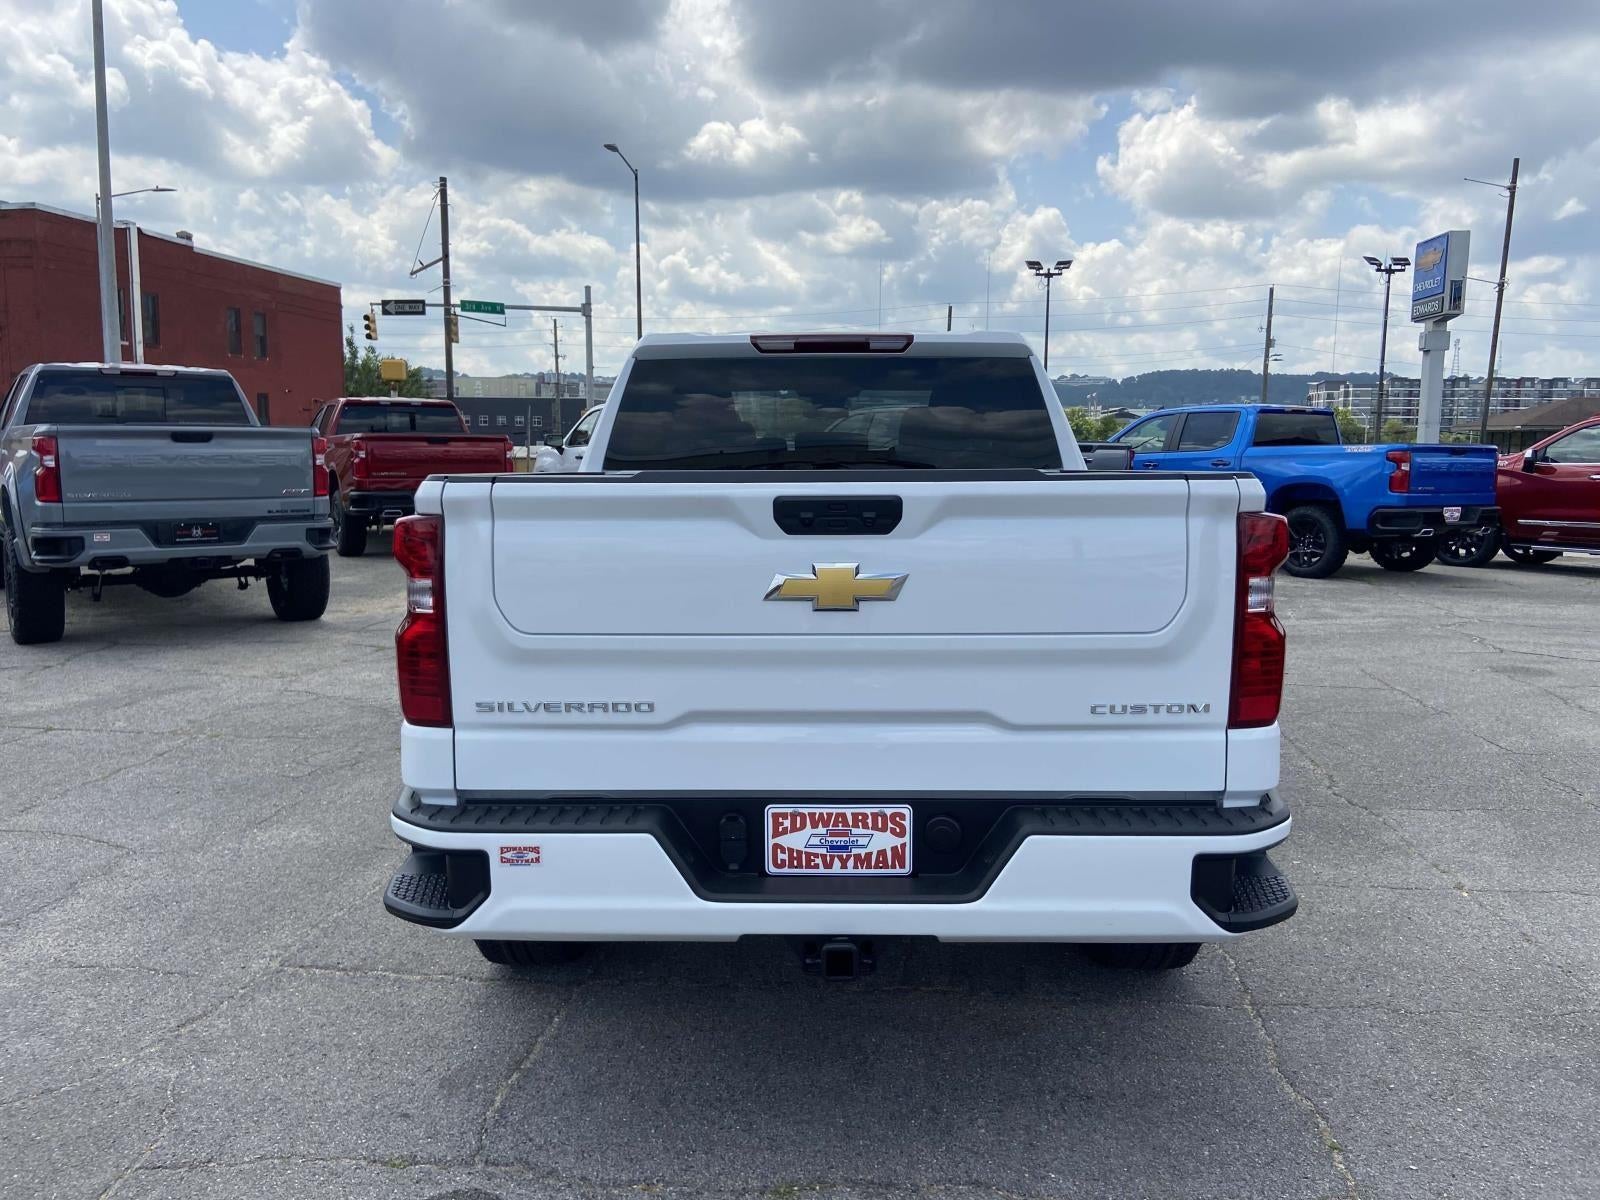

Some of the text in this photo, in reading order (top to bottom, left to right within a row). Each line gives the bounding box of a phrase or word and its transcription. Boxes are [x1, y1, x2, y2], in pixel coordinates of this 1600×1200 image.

[1413, 276, 1441, 293] CHEVROLET
[480, 303, 491, 311] Ave
[1413, 300, 1439, 316] EDWARDS
[475, 701, 655, 714] SILVERADO
[1090, 703, 1211, 715] CUSTOM
[771, 811, 907, 840] EDWARDS
[819, 837, 859, 846] Chevrolet
[500, 846, 541, 855] EDWARDS
[771, 842, 907, 870] CHEVYMAN
[500, 855, 541, 864] CHEVYMAN
